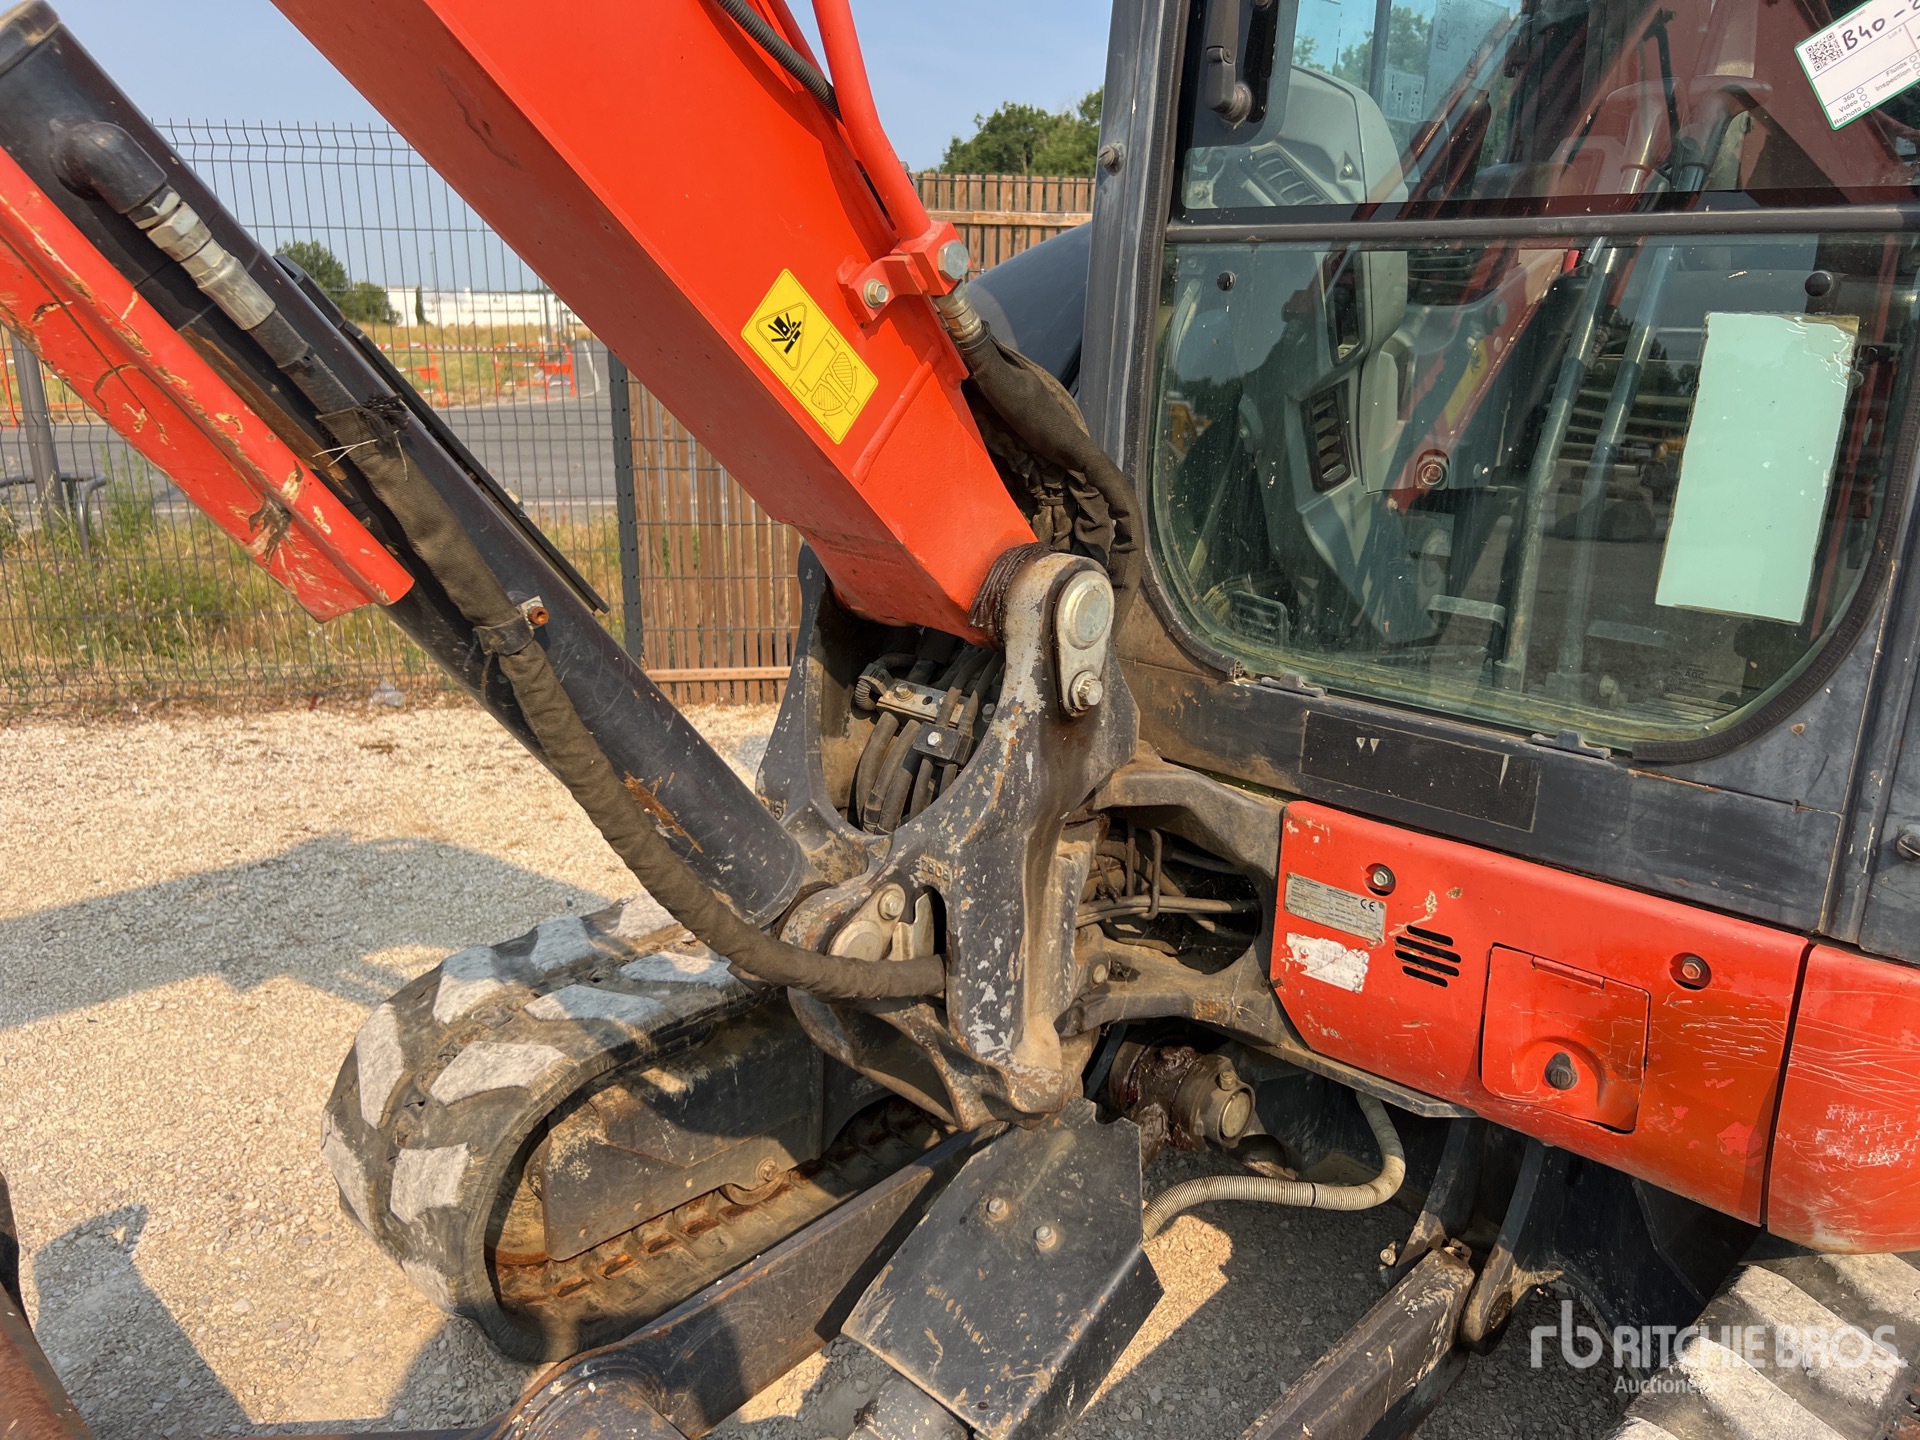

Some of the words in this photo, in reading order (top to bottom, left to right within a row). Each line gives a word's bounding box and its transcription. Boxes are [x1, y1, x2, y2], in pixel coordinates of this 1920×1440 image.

[1885, 61, 1907, 76] Fluids
[1875, 68, 1911, 91] Inspection
[1843, 92, 1855, 103] 360
[1838, 99, 1858, 112] Video
[1834, 106, 1862, 125] Rephoto
[1684, 670, 1704, 680] AGC
